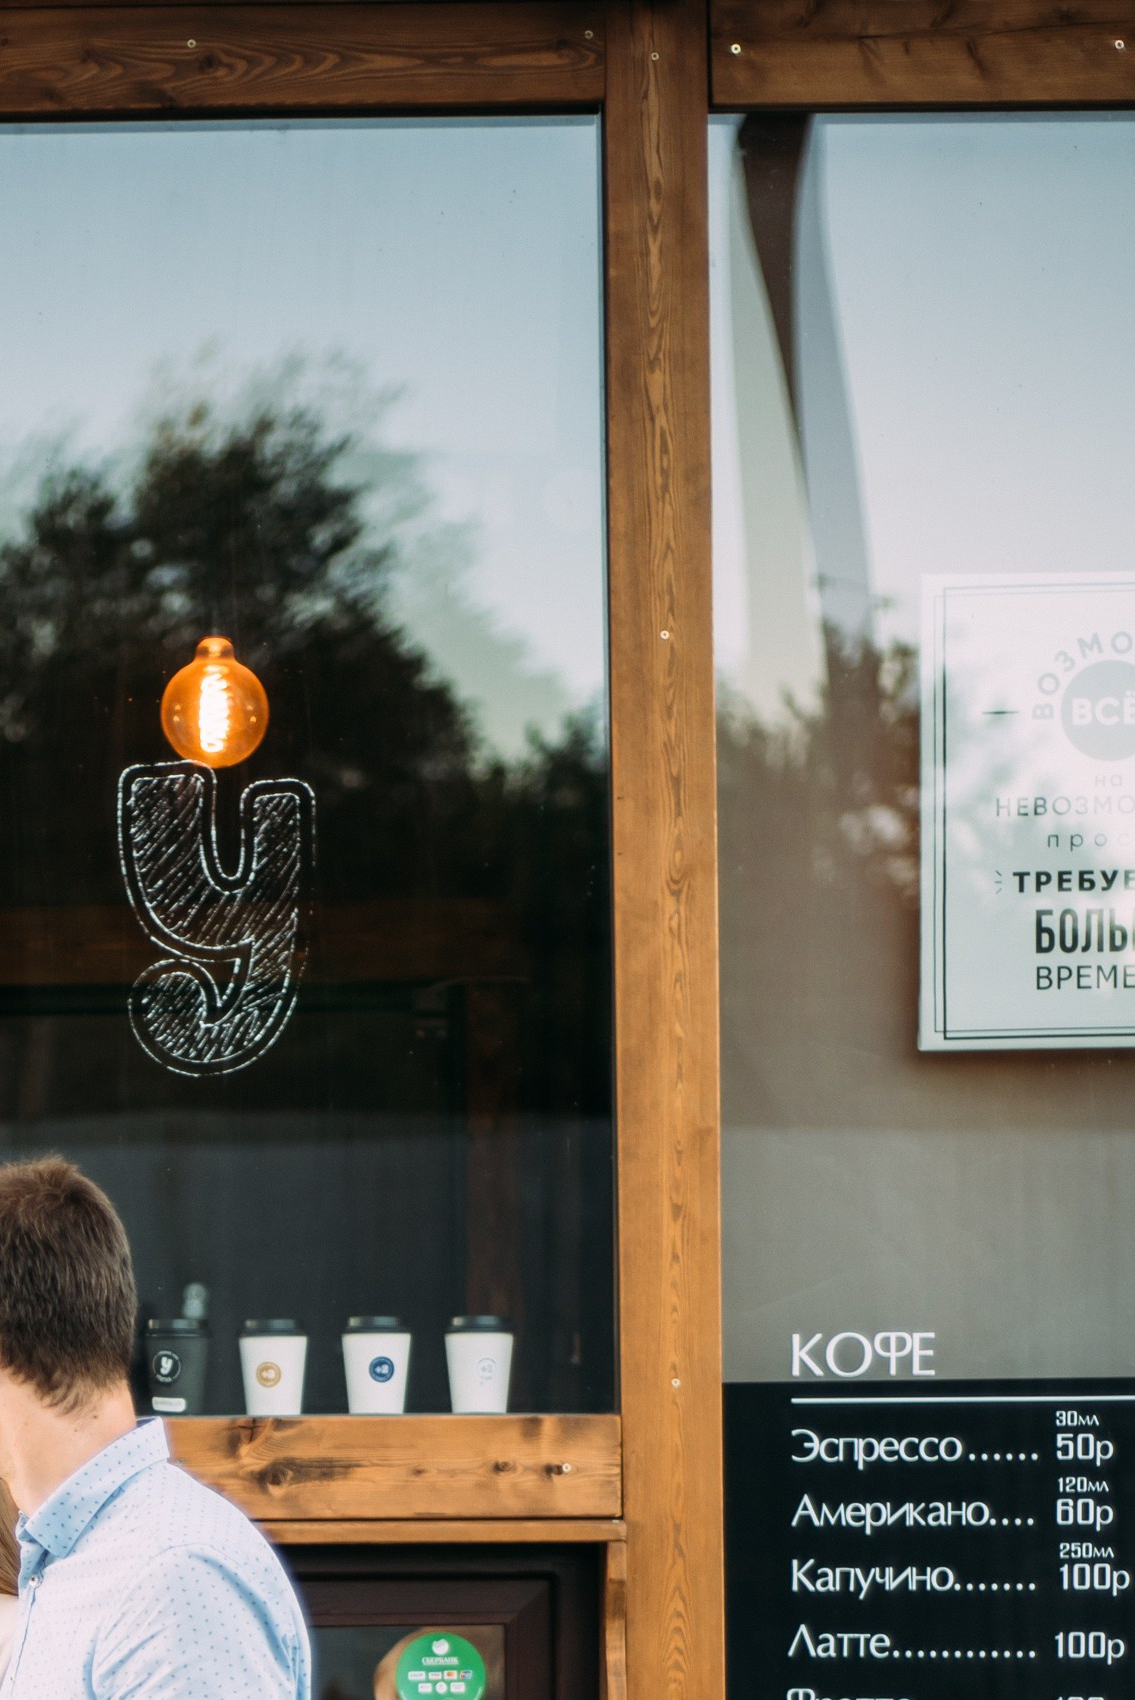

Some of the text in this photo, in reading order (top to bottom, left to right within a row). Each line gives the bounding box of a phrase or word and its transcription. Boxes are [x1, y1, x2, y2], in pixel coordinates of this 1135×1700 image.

[1035, 908, 1135, 954] БОЛЬ
[791, 1331, 936, 1378] КОФЕ
[1055, 1410, 1100, 1427] 30мл
[1056, 1433, 1114, 1467] 50р
[1057, 1477, 1110, 1493] 120мл
[1056, 1498, 1114, 1532] 60р
[1059, 1542, 1115, 1559] 250мл
[1059, 1563, 1131, 1597] 100р
[1054, 1631, 1126, 1666] 100р
